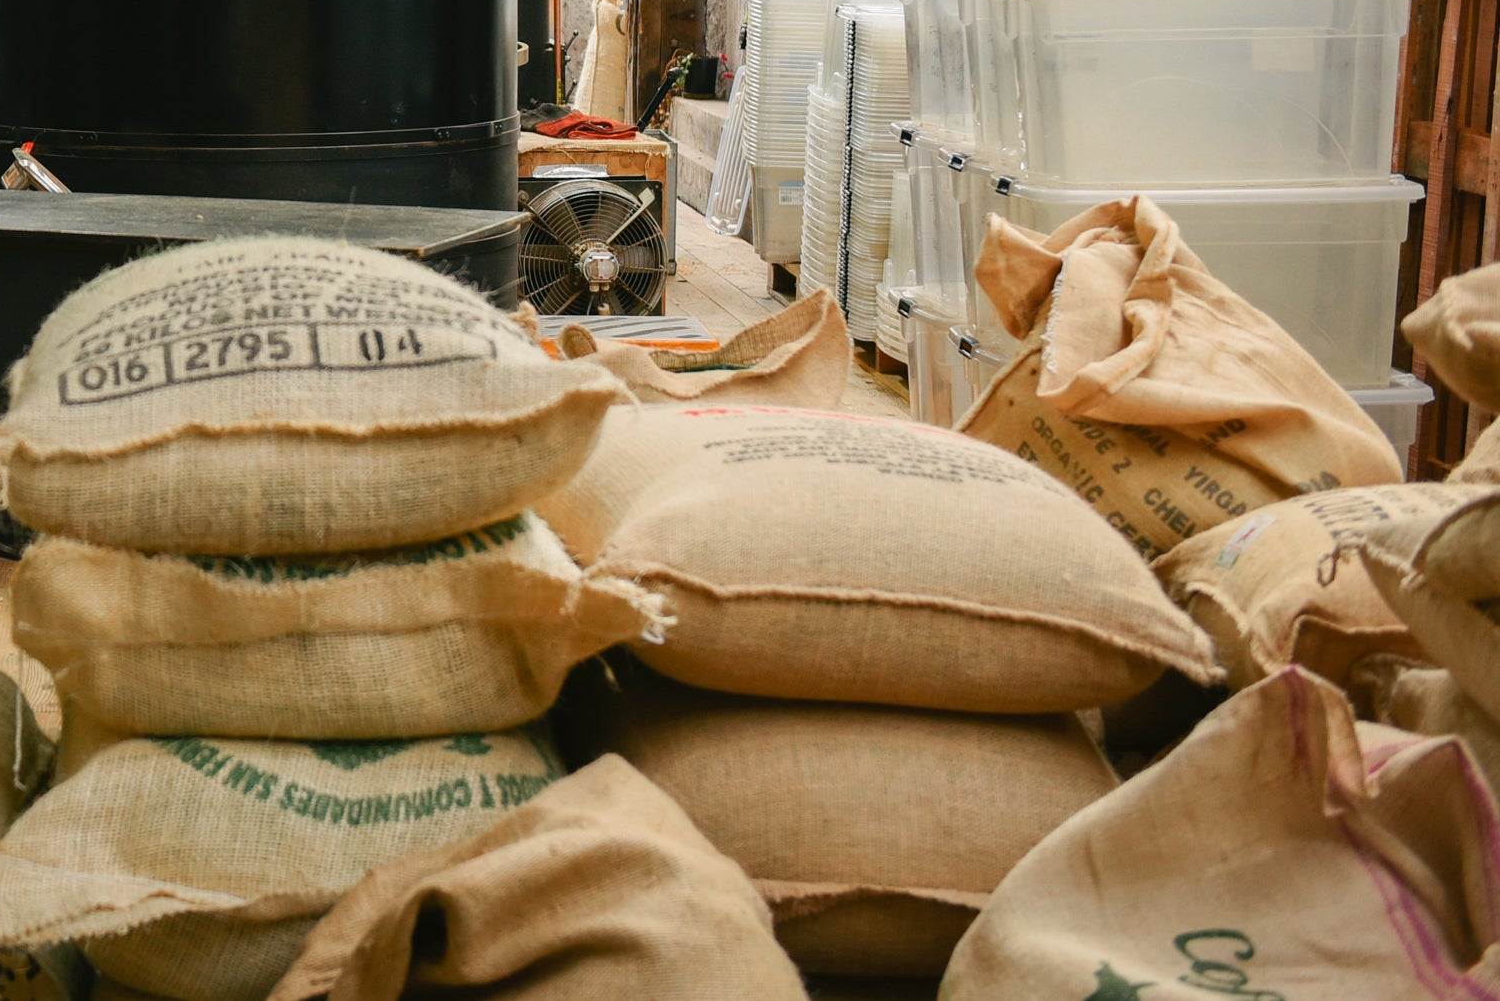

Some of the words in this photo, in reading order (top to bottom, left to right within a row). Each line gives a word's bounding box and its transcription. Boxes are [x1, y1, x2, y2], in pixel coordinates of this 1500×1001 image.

[243, 302, 312, 322] NET
[185, 329, 292, 371] 2795
[78, 358, 150, 391] 016
[1032, 415, 1104, 504] ORGANIC
[222, 759, 279, 801] SAN
[279, 777, 471, 826] COMUNIDADES
